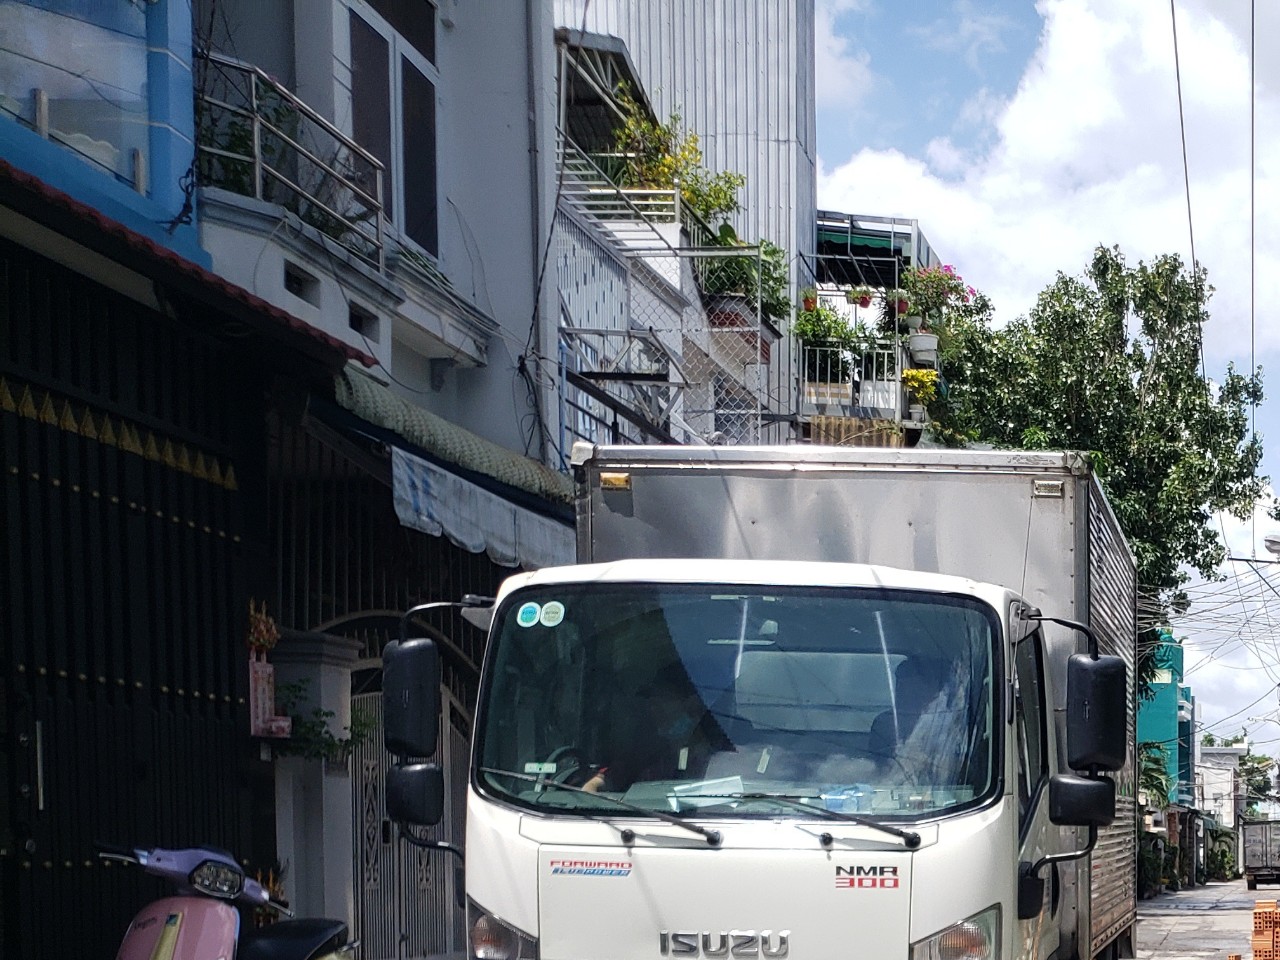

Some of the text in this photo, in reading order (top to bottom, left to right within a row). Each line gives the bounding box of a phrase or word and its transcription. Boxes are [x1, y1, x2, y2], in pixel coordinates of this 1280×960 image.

[550, 860, 633, 868] FORWARD
[835, 865, 898, 876] NMR
[835, 877, 899, 888] 300
[659, 929, 791, 960] ISUZU
